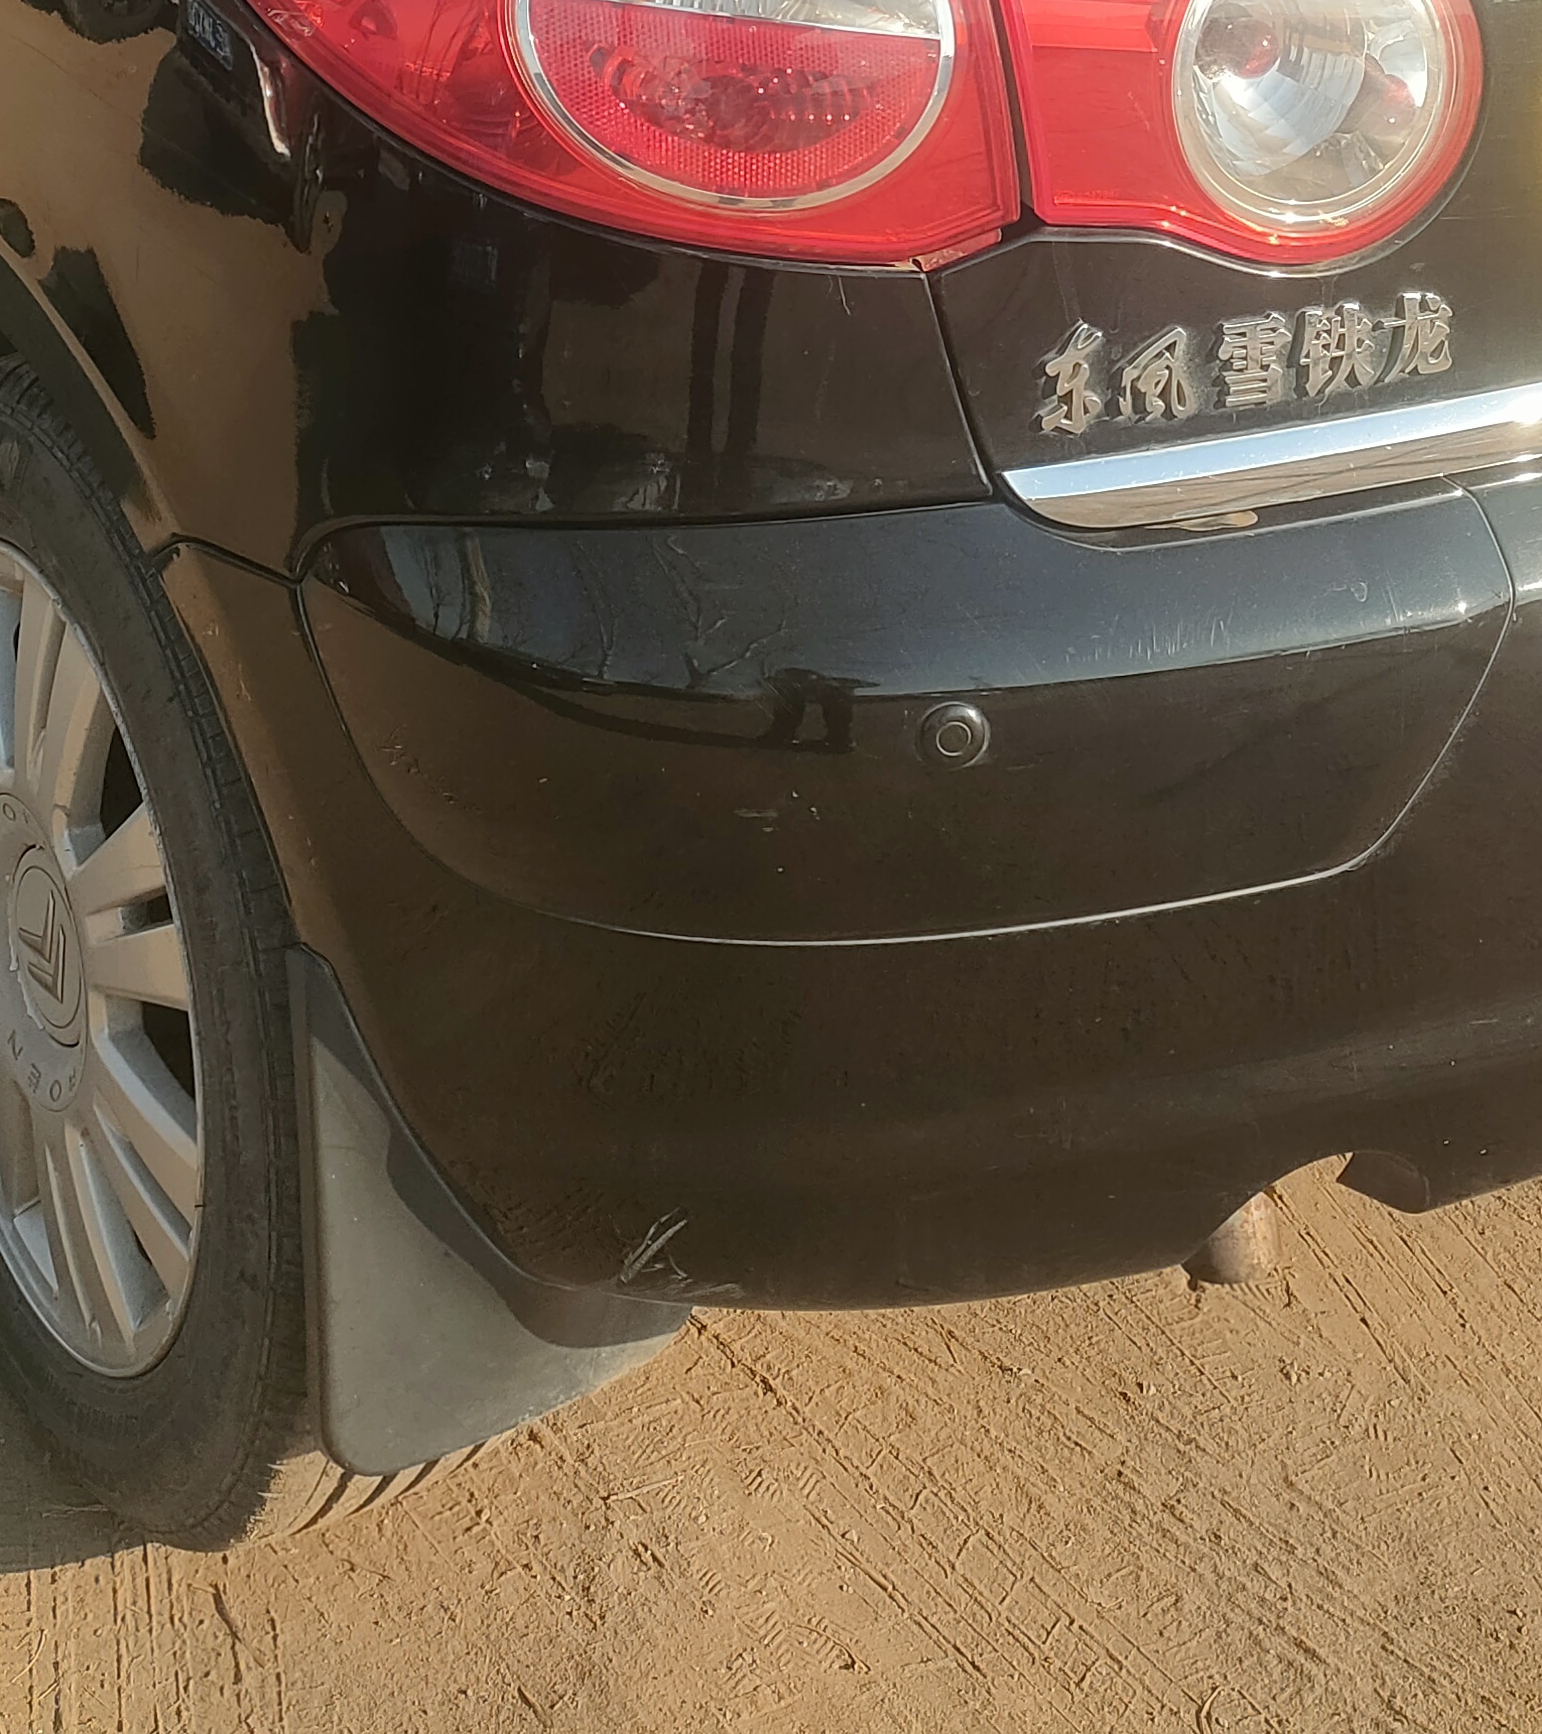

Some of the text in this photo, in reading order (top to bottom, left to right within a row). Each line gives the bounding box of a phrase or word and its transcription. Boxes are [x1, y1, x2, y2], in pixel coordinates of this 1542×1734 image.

[1033, 291, 1455, 436] 东风雪铁龙
